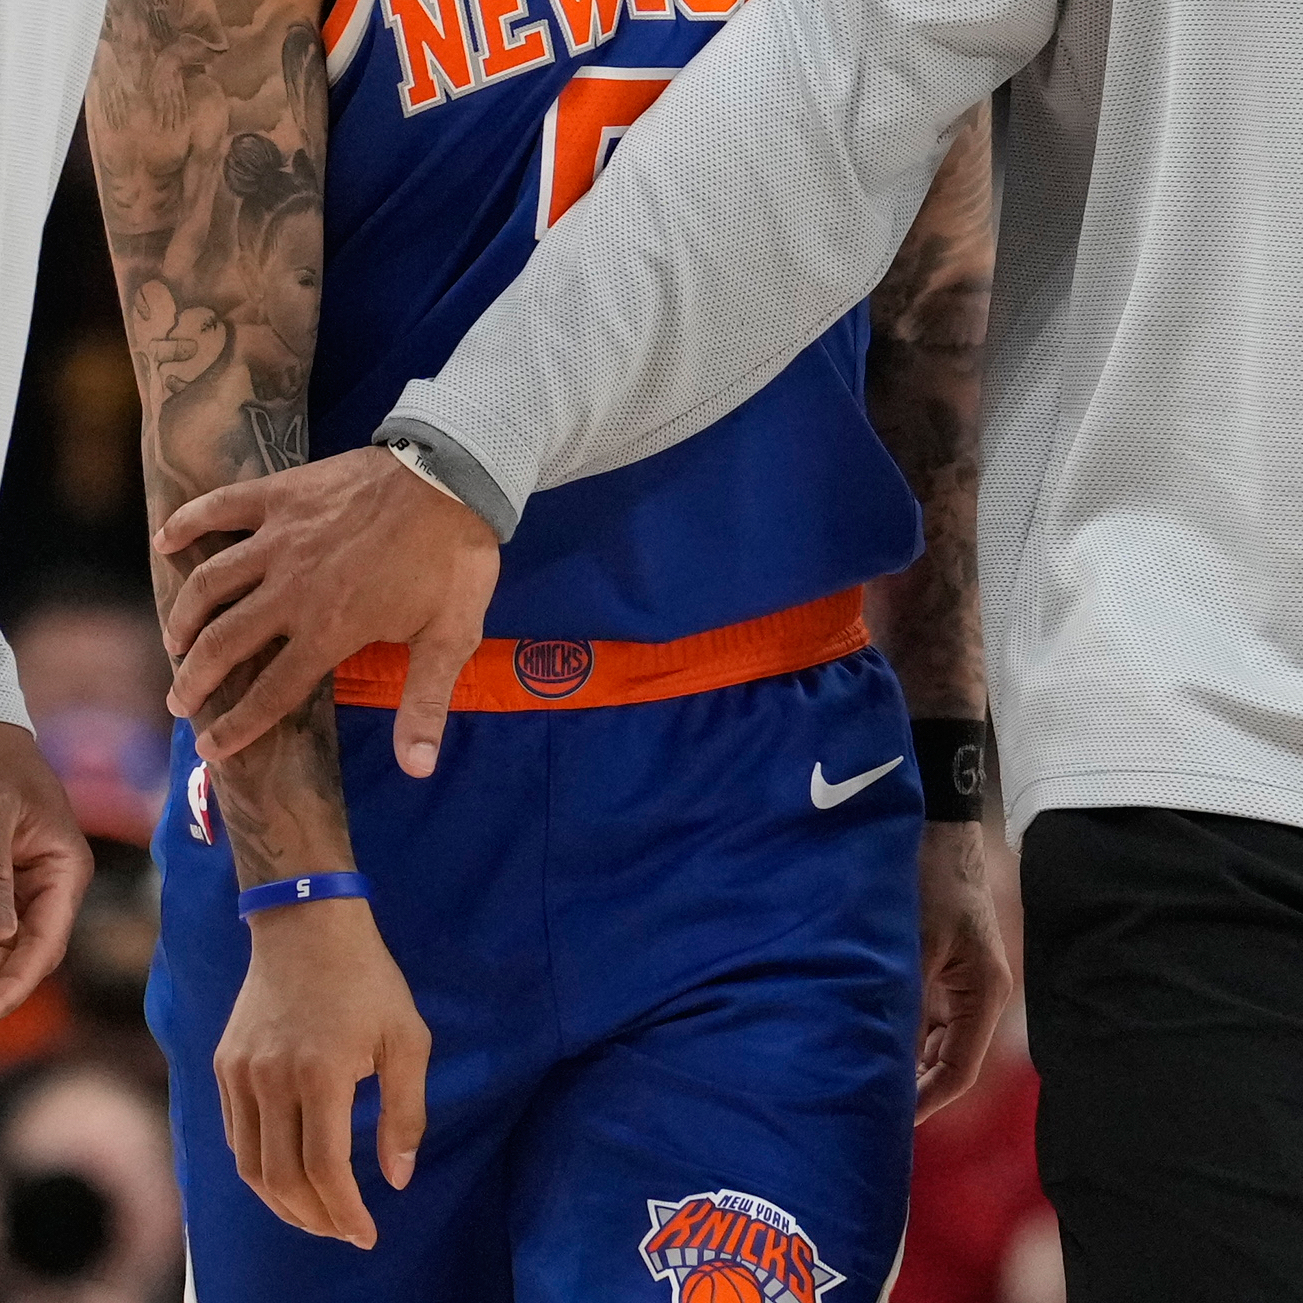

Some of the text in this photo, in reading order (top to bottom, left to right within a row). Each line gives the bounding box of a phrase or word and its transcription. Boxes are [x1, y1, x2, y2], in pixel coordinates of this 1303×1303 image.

[523, 643, 584, 677] KNICKS
[719, 1194, 790, 1234] NEW YORK
[646, 1197, 815, 1303] KNICKS
